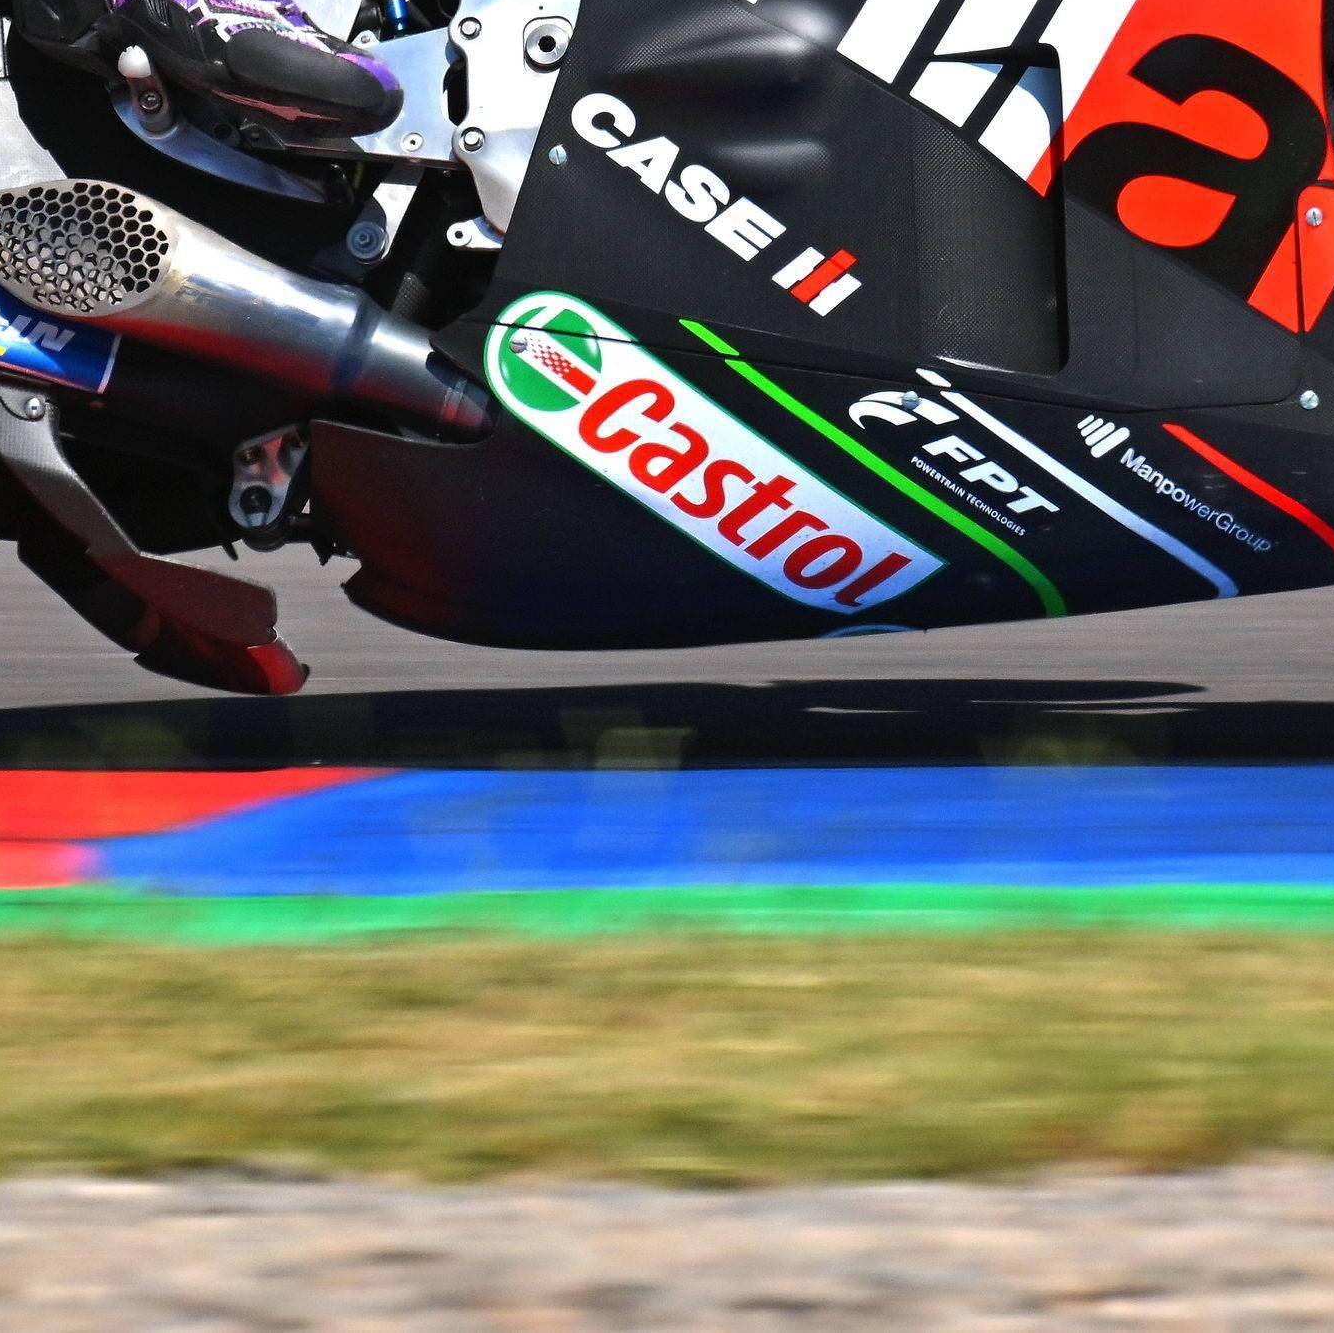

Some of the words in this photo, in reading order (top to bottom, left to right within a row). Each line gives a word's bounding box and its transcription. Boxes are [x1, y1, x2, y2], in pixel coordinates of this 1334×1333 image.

[570, 91, 786, 264] CASE
[576, 376, 912, 613] Castrol
[910, 455, 966, 499] POWERTRAIN
[965, 492, 1027, 538] TECHNOLOGIES
[921, 434, 1061, 515] FPT
[1119, 447, 1273, 552] ManpowerGroup
